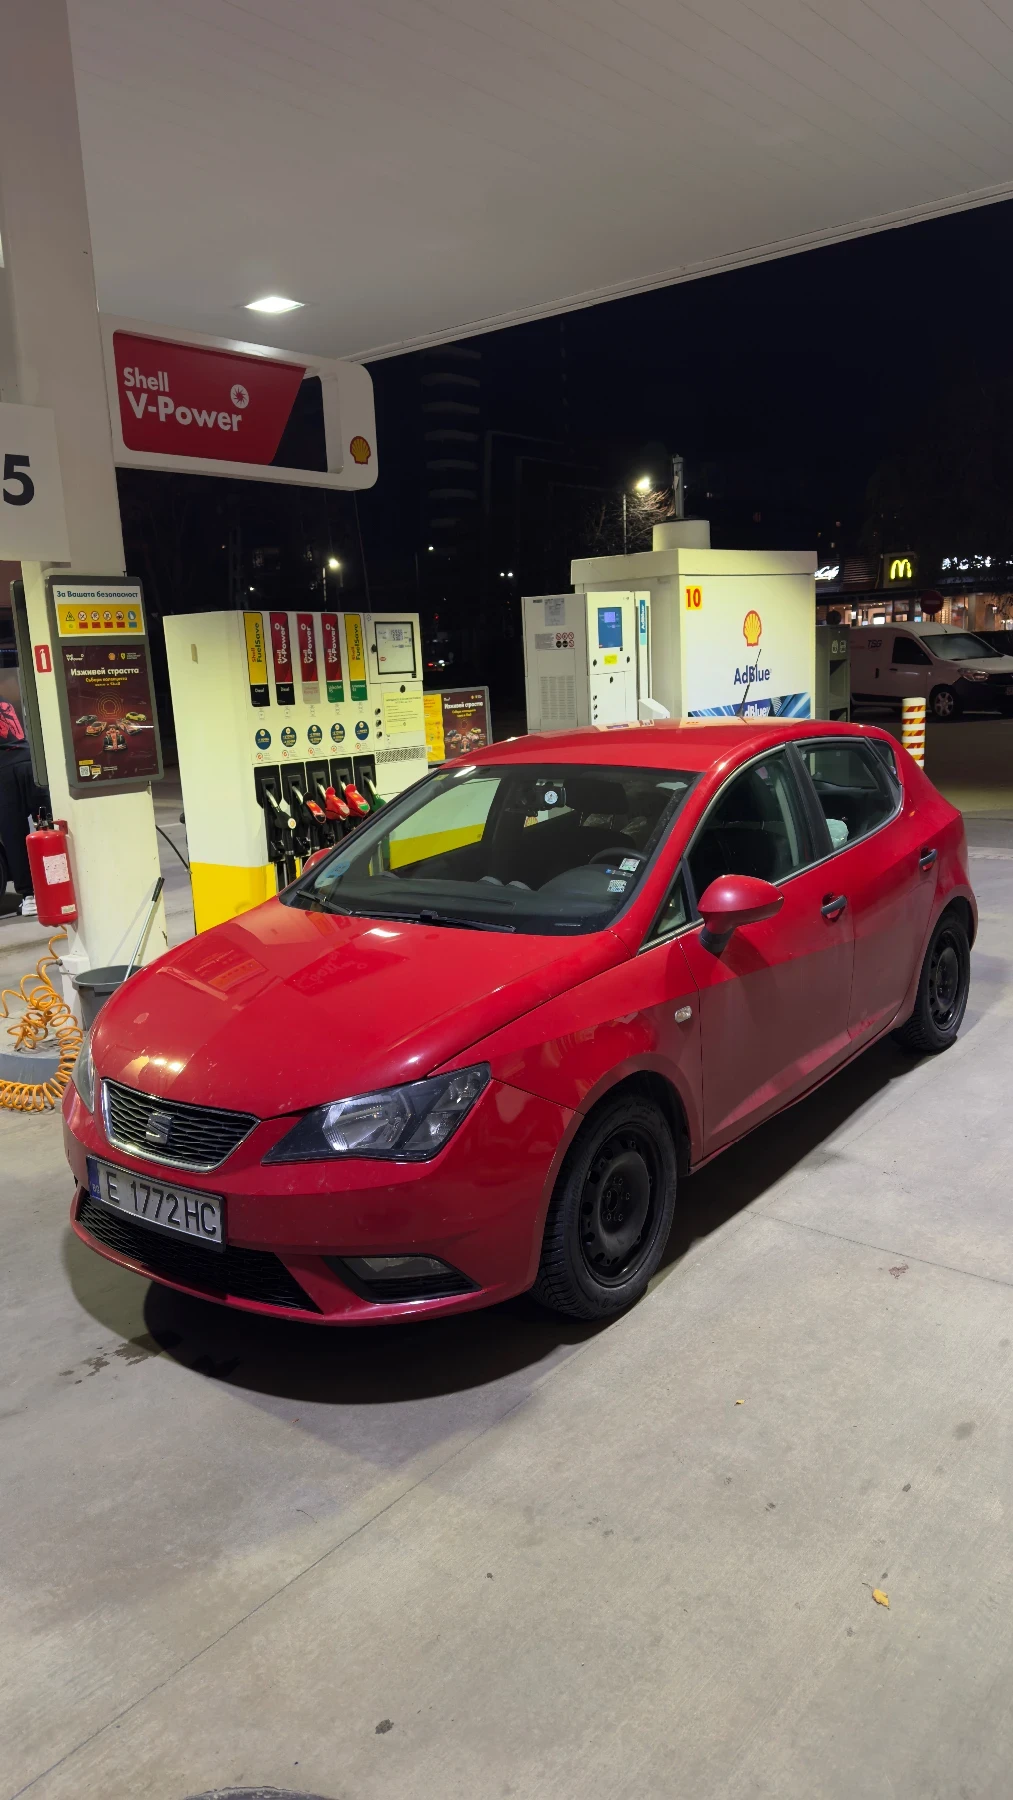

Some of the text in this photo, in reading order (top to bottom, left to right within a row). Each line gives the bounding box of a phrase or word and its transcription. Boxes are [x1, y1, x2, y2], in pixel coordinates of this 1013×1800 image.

[123, 367, 169, 392] Shell
[125, 391, 242, 431] V-Power
[3, 454, 34, 506] 5
[686, 588, 701, 608] 10
[71, 667, 106, 677] Изживей
[733, 664, 770, 685] AdBlue
[106, 1171, 217, 1235] E 1772HC
